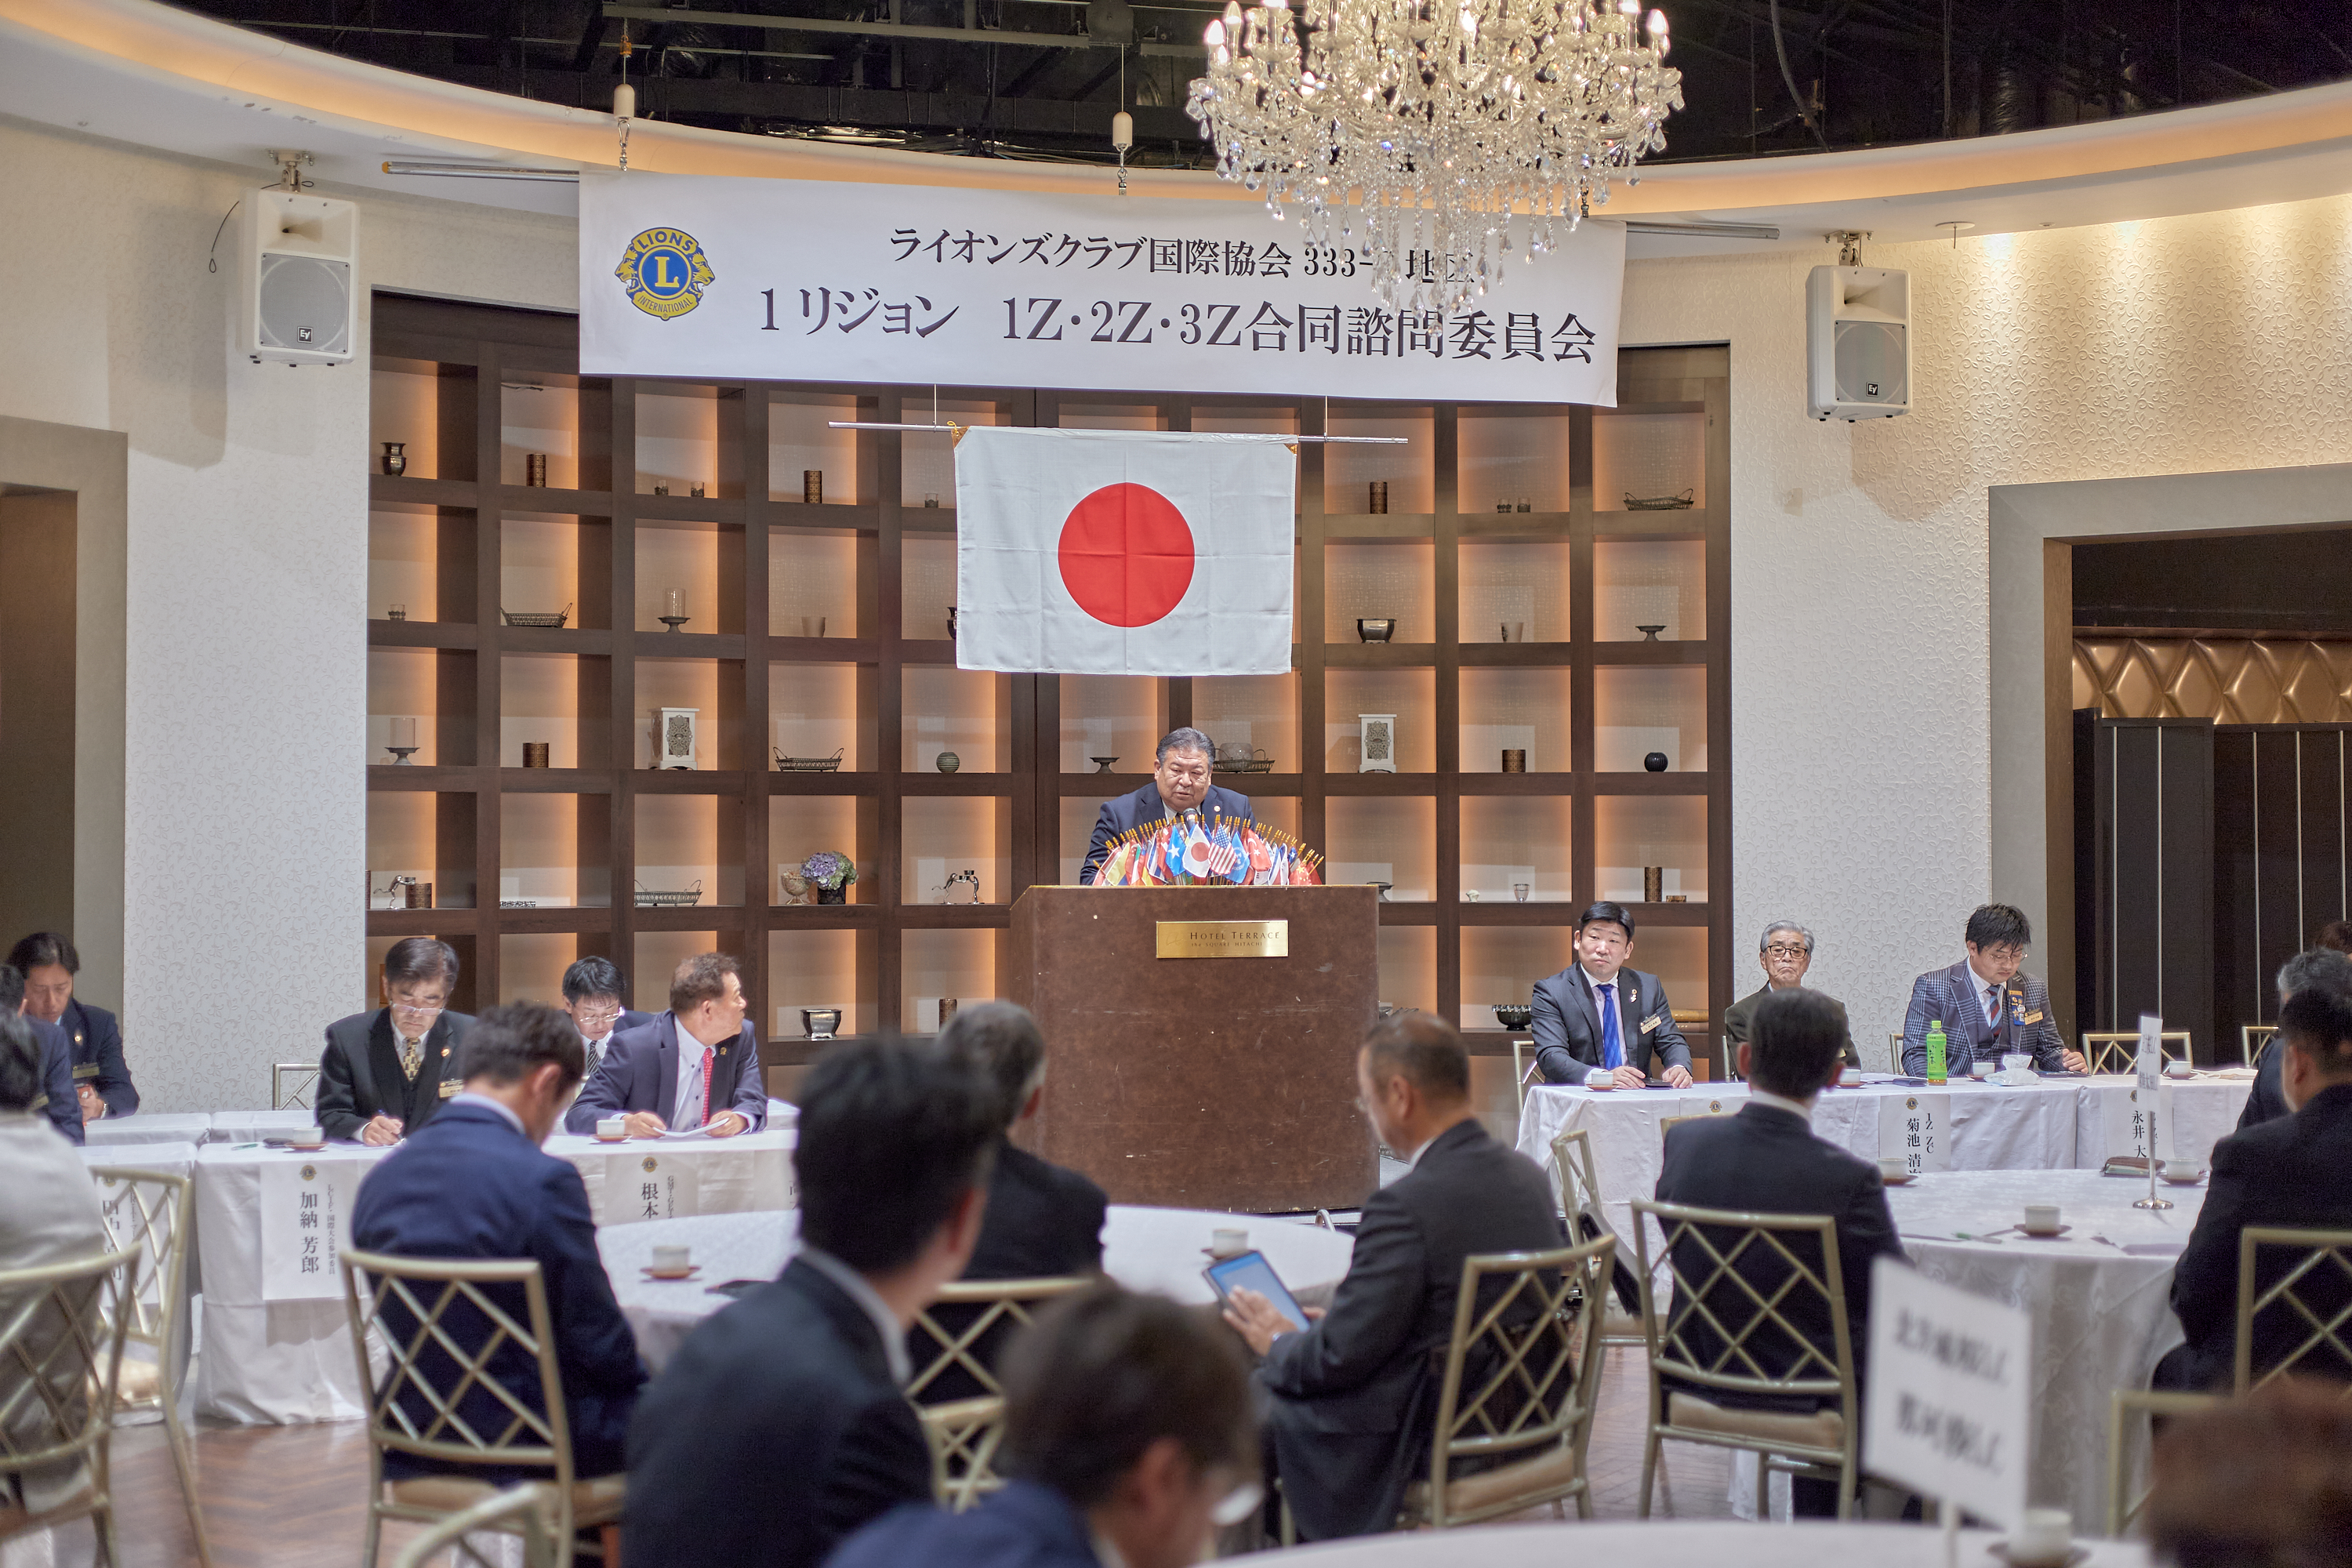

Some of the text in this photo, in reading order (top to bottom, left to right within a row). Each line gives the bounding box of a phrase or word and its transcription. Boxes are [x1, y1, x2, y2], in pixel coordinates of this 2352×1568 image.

[637, 231, 693, 252] LIONS
[891, 229, 1292, 278] ライオンズクラブ国際協会
[655, 256, 680, 288] L
[637, 295, 693, 313] INTERNATIONAL
[1190, 931, 1225, 940] HOTEL
[1907, 1118, 1921, 1148] 菊池
[2132, 1110, 2145, 1139] 永井
[641, 1182, 659, 1219] 根本
[299, 1192, 319, 1274] 加納 芳郎
